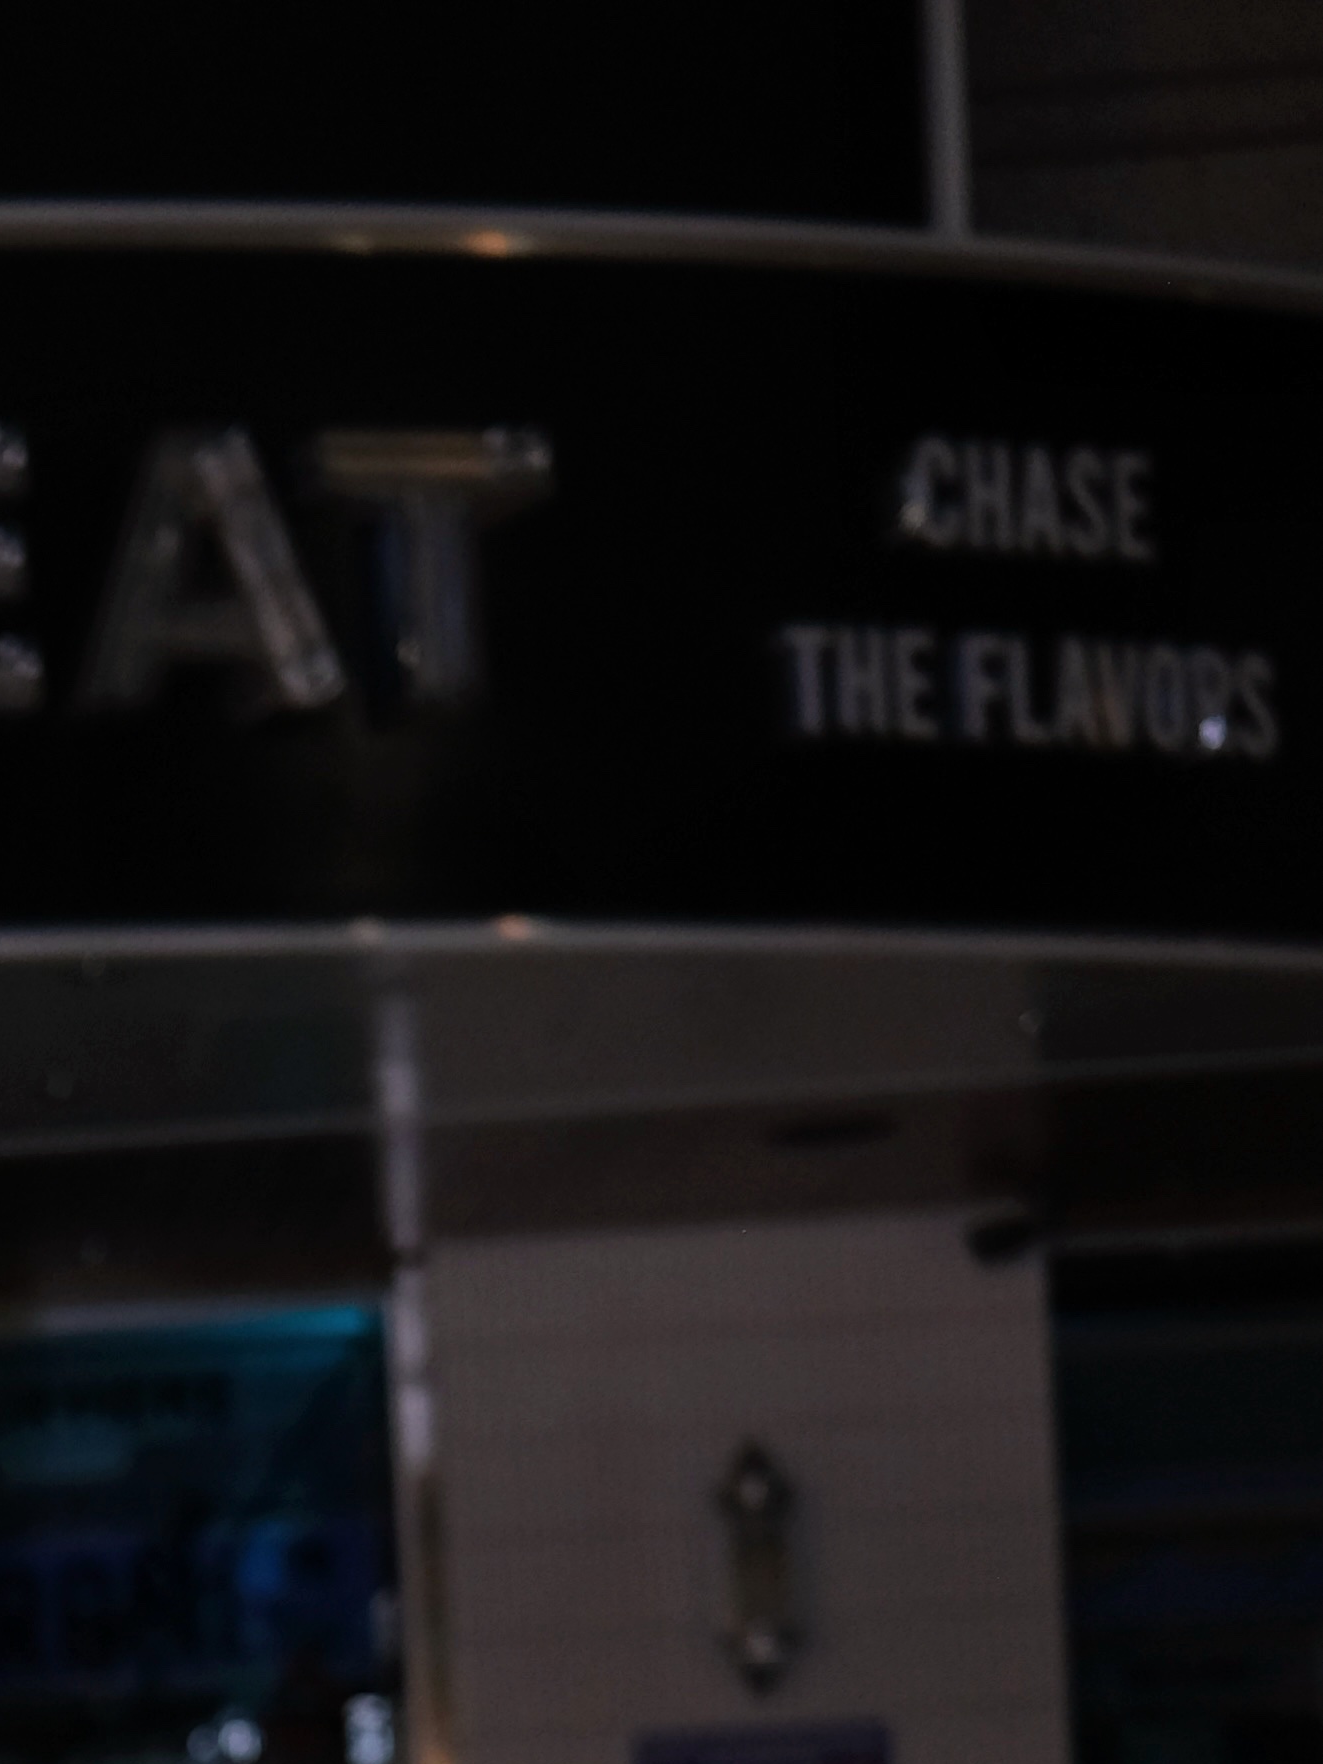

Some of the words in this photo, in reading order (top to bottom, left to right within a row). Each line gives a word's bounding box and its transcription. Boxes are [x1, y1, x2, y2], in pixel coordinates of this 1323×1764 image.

[899, 436, 1155, 562] CHASE
[779, 620, 938, 742] THE
[958, 630, 1280, 758] FLAVORS
